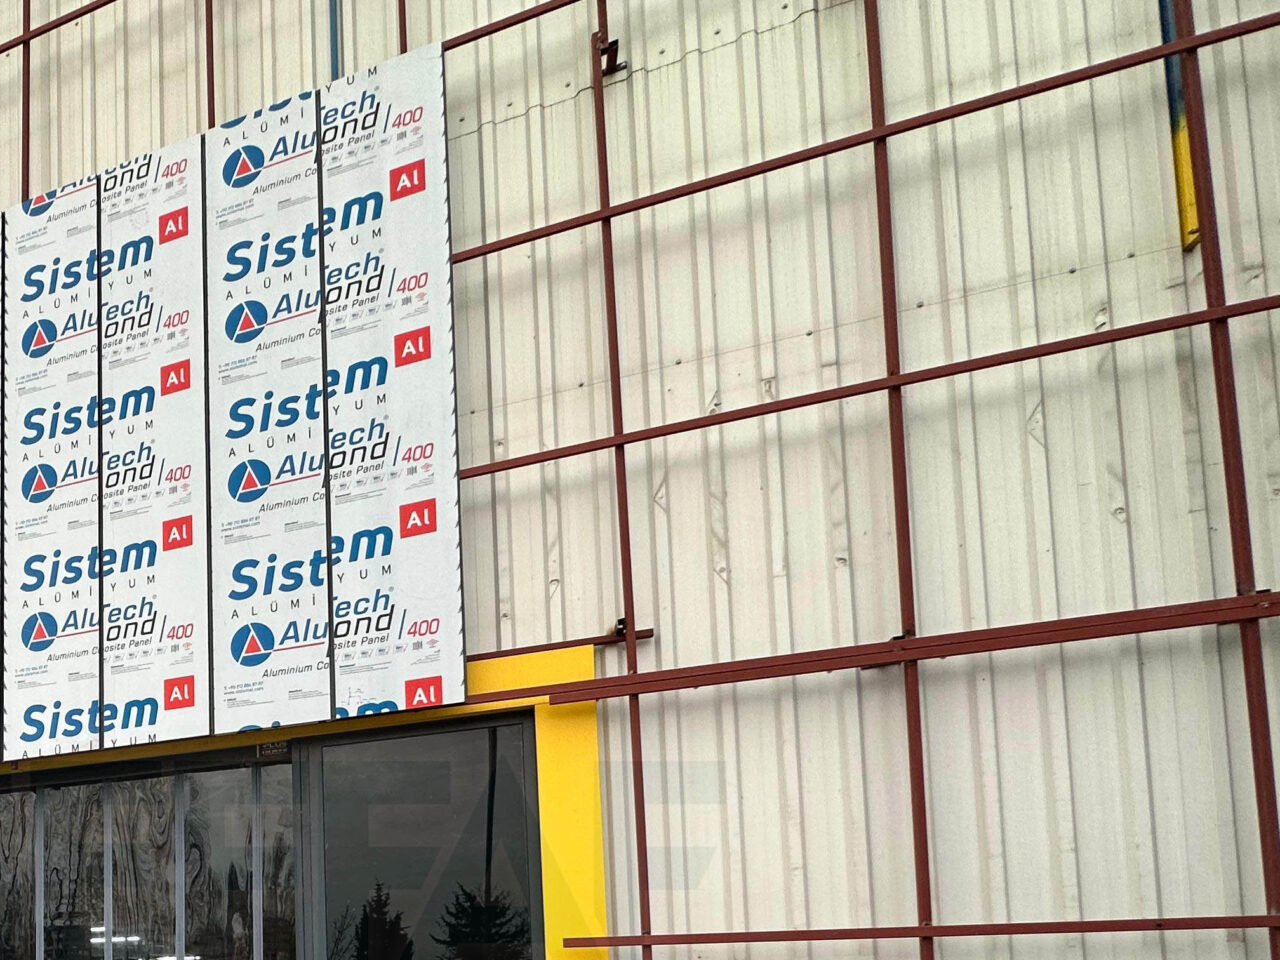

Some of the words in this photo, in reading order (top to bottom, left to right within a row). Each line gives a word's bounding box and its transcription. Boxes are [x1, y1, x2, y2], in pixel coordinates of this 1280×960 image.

[165, 216, 182, 236] Al
[166, 368, 184, 387] Al
[168, 524, 187, 543] Al
[170, 684, 189, 701] Al
